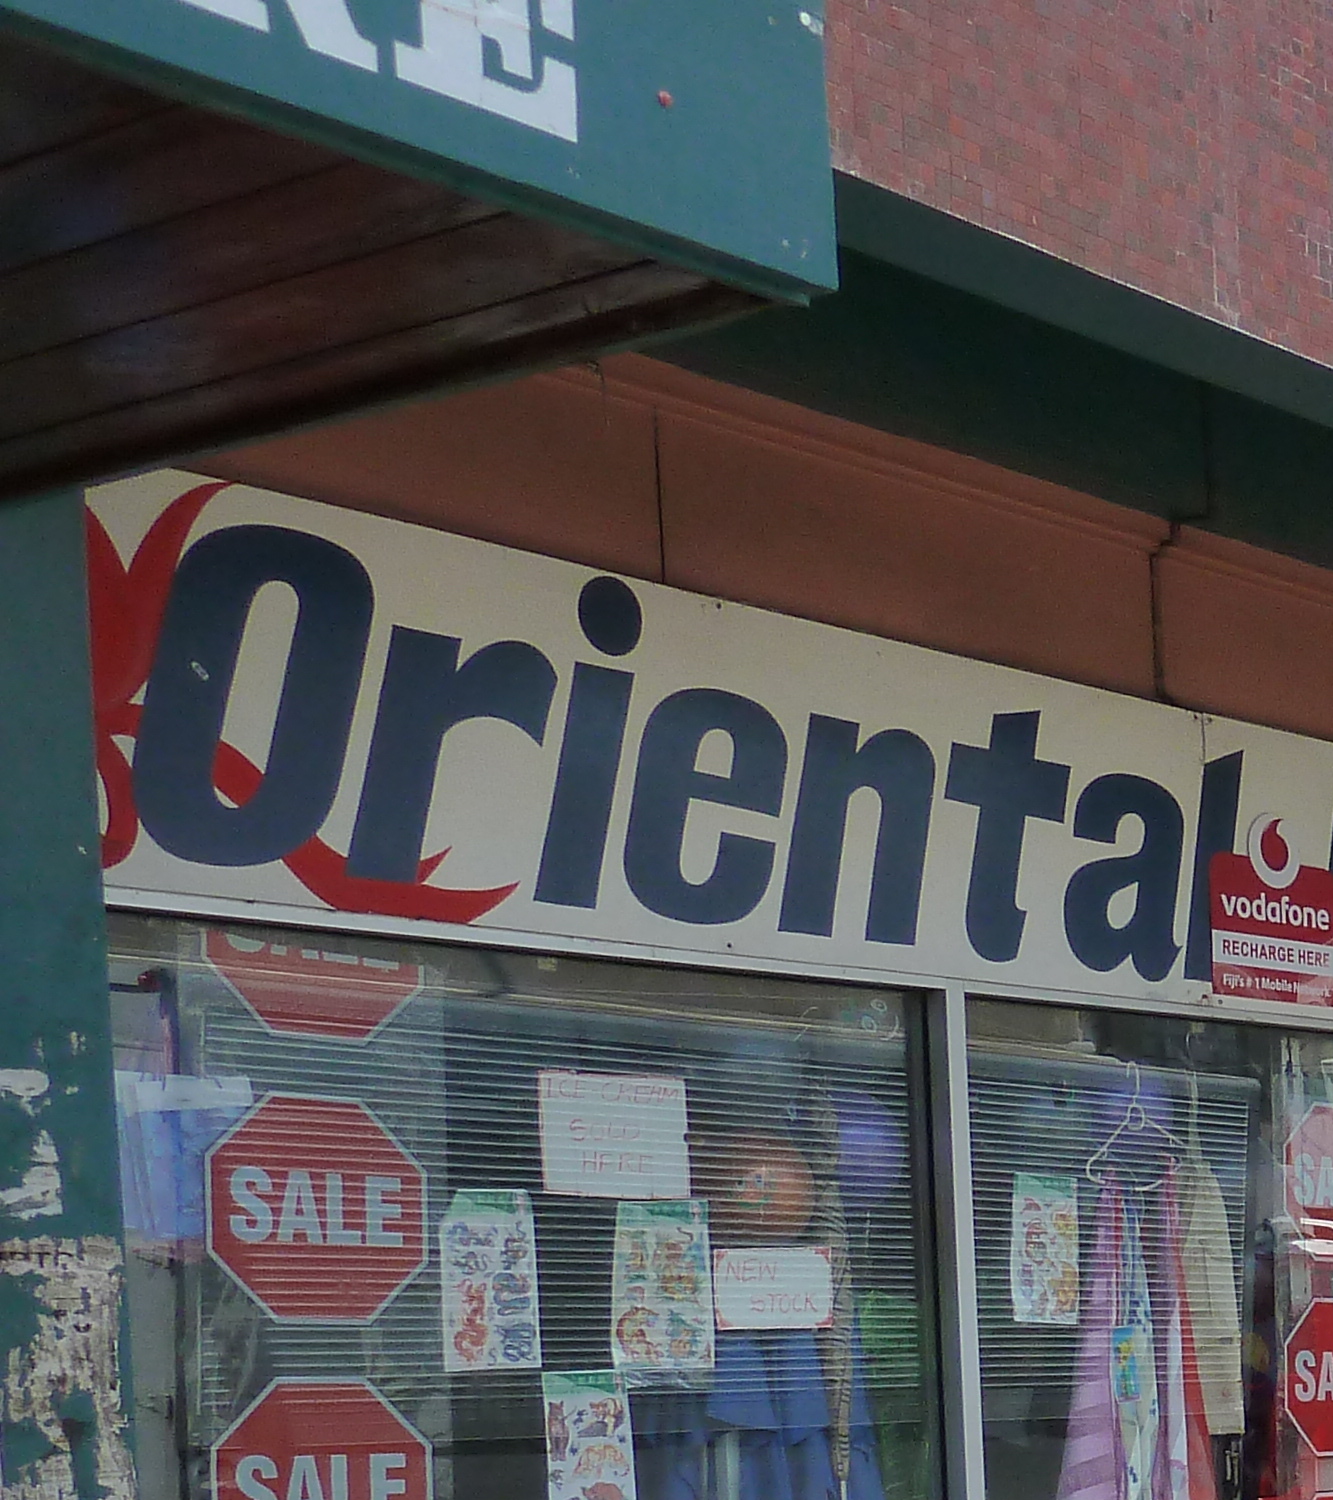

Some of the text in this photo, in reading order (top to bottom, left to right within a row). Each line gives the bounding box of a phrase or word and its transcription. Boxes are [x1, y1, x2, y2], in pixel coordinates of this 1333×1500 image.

[132, 522, 1243, 983] Oriental
[1220, 892, 1330, 931] vodafone
[1222, 939, 1330, 968] RECHARGE HERE
[1223, 973, 1245, 990] Fiji's
[1261, 979, 1292, 992] Mobile
[229, 1166, 404, 1247] SALE
[726, 1259, 778, 1282] NEW
[750, 1293, 818, 1314] STOCK
